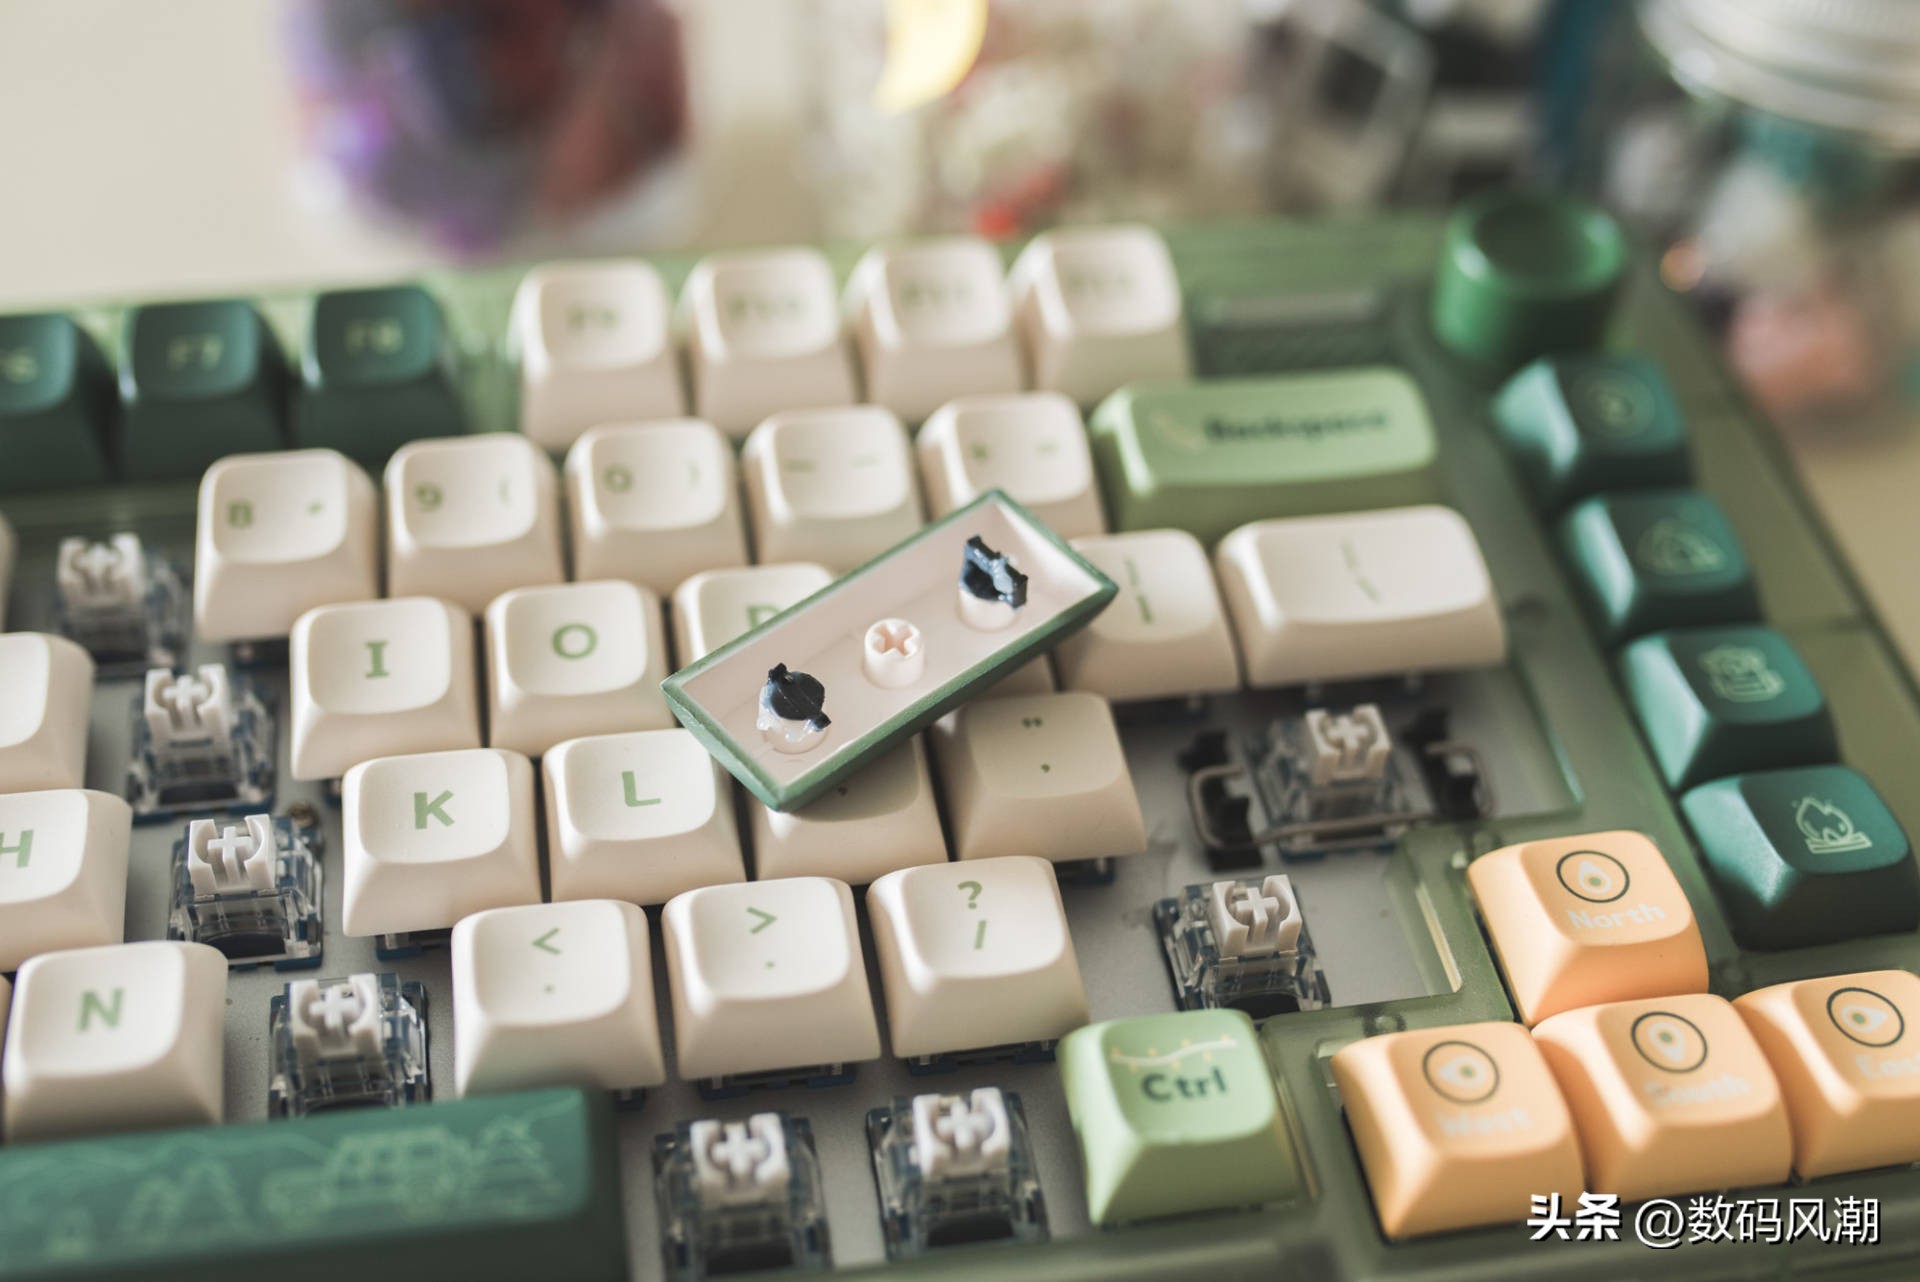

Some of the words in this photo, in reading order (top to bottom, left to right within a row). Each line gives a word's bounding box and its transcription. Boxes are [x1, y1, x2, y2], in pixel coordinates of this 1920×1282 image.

[414, 482, 445, 512] 9
[226, 499, 254, 529] 8
[551, 623, 598, 660] O
[363, 640, 390, 679] I
[621, 770, 661, 807] L
[413, 791, 455, 830] K
[957, 880, 984, 910] ?
[746, 906, 777, 935] >
[1566, 901, 1667, 930] North
[531, 927, 561, 956] <
[973, 919, 987, 950] /
[77, 986, 125, 1034] N
[1141, 1064, 1227, 1101] Ctrl
